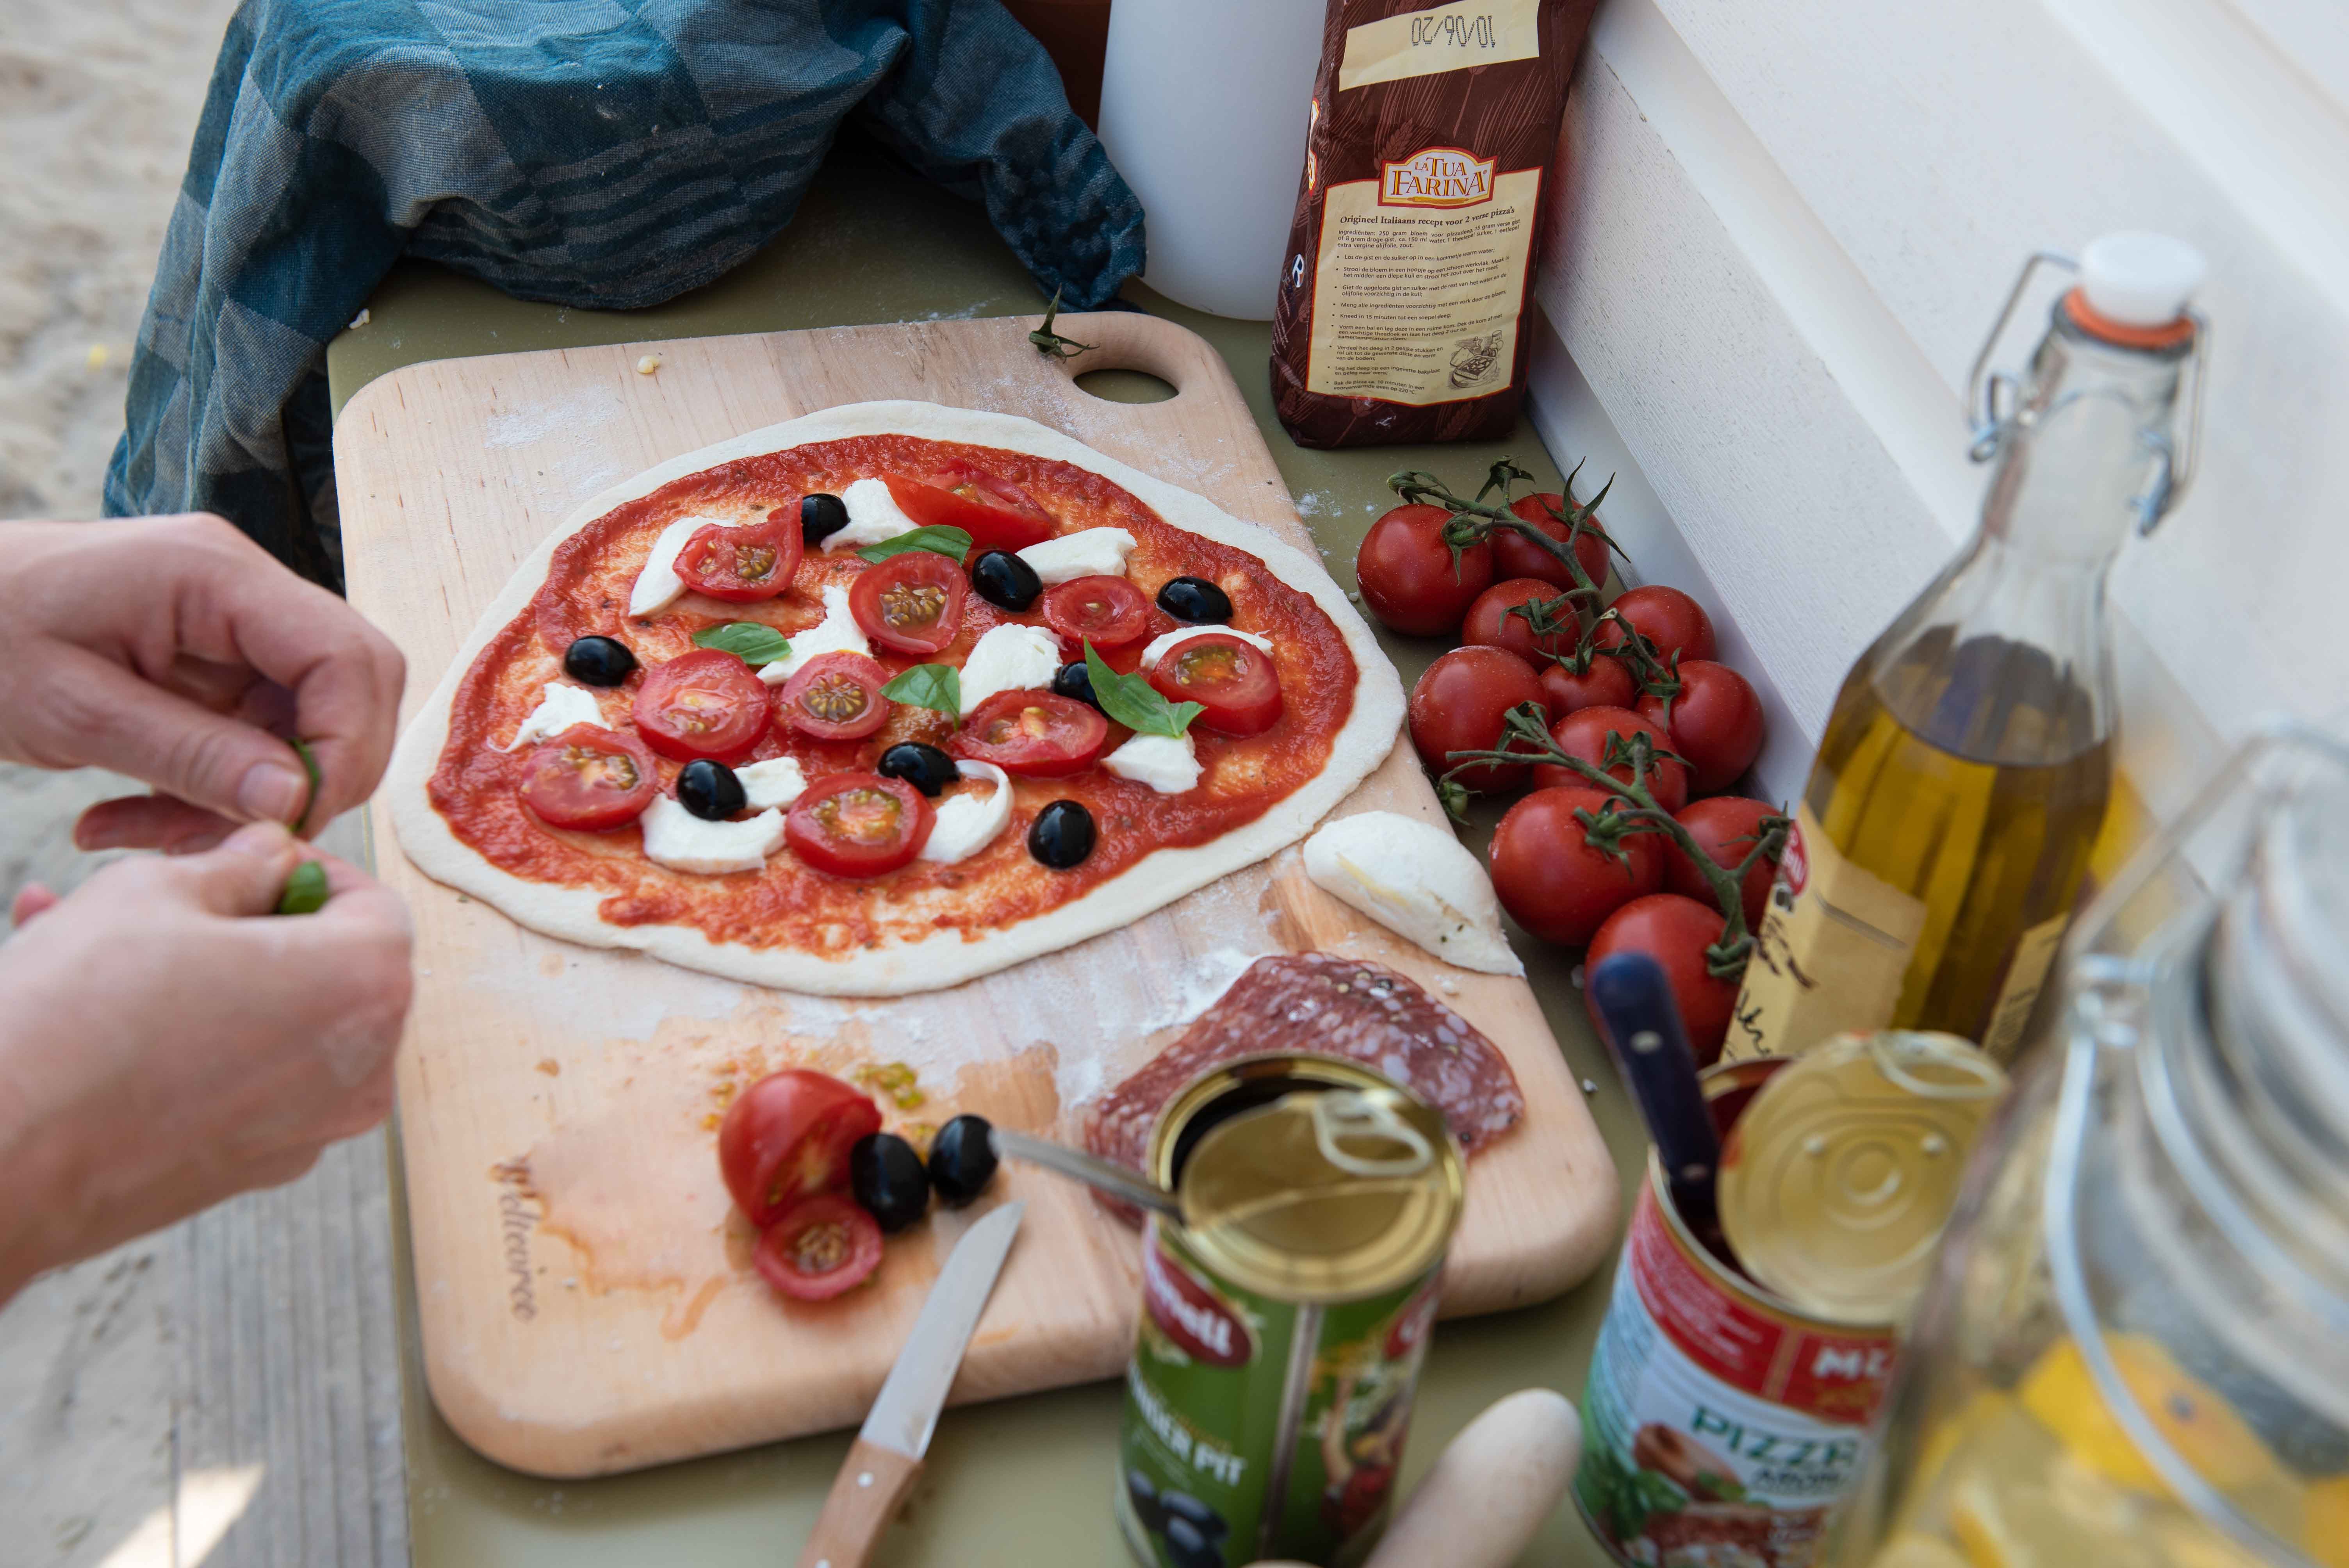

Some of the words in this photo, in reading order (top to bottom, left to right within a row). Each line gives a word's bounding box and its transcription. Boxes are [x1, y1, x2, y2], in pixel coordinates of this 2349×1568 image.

[1412, 15, 1495, 47] 10/06/20
[1415, 162, 1428, 171] LA
[1340, 215, 1378, 225] Origineel
[1381, 216, 1415, 224] Italiaans
[1418, 219, 1443, 228] recept
[1472, 213, 1489, 221] verse
[1491, 206, 1515, 219] pizza's
[1453, 234, 1475, 242] theelepel
[1499, 225, 1519, 233] eetlepel
